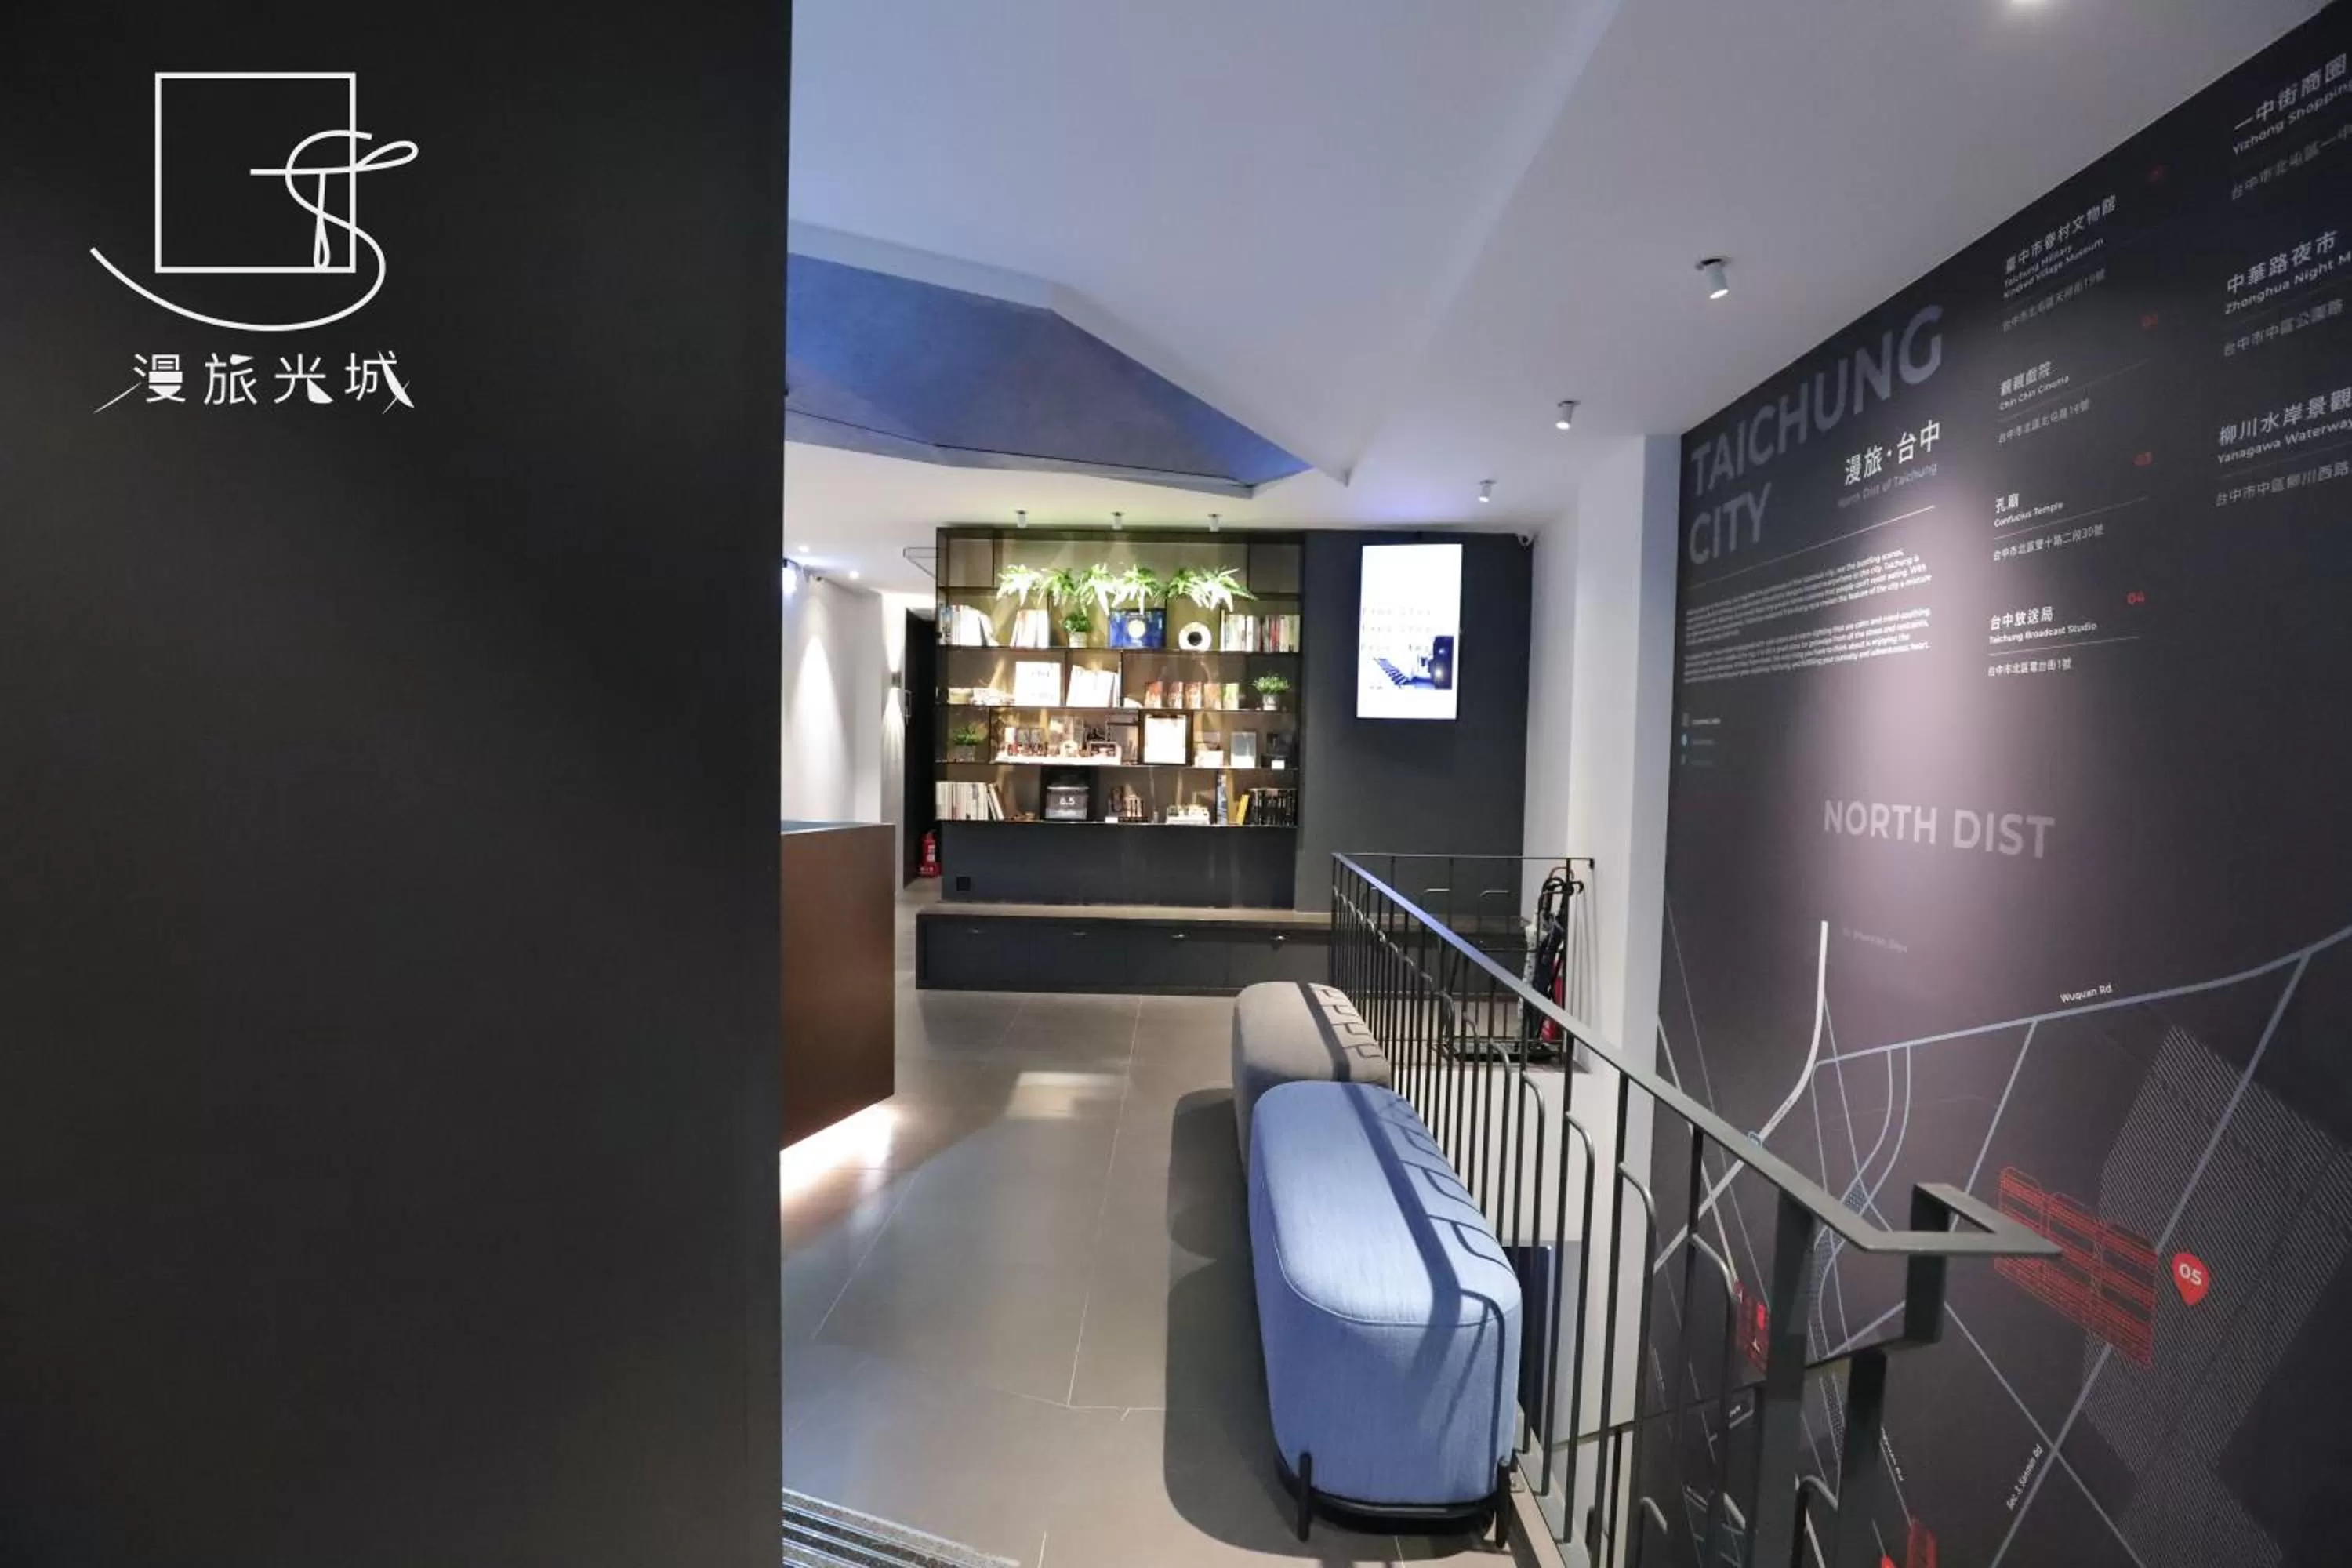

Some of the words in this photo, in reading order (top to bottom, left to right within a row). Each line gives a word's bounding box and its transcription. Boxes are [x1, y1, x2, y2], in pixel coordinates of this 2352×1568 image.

[2227, 230, 2338, 294] 中華路夜市
[1690, 304, 1944, 496] TAICHUNG
[2219, 386, 2352, 447] 柳川水岸景觀
[2217, 439, 2281, 464] Yanagawa
[1689, 481, 1772, 565] CITY
[1990, 605, 2053, 631] 台中放送局
[1824, 800, 1938, 844] NORTH
[1952, 808, 2056, 859] DIST
[2060, 988, 2097, 1004] Wuquan
[2179, 1262, 2202, 1286] 05
